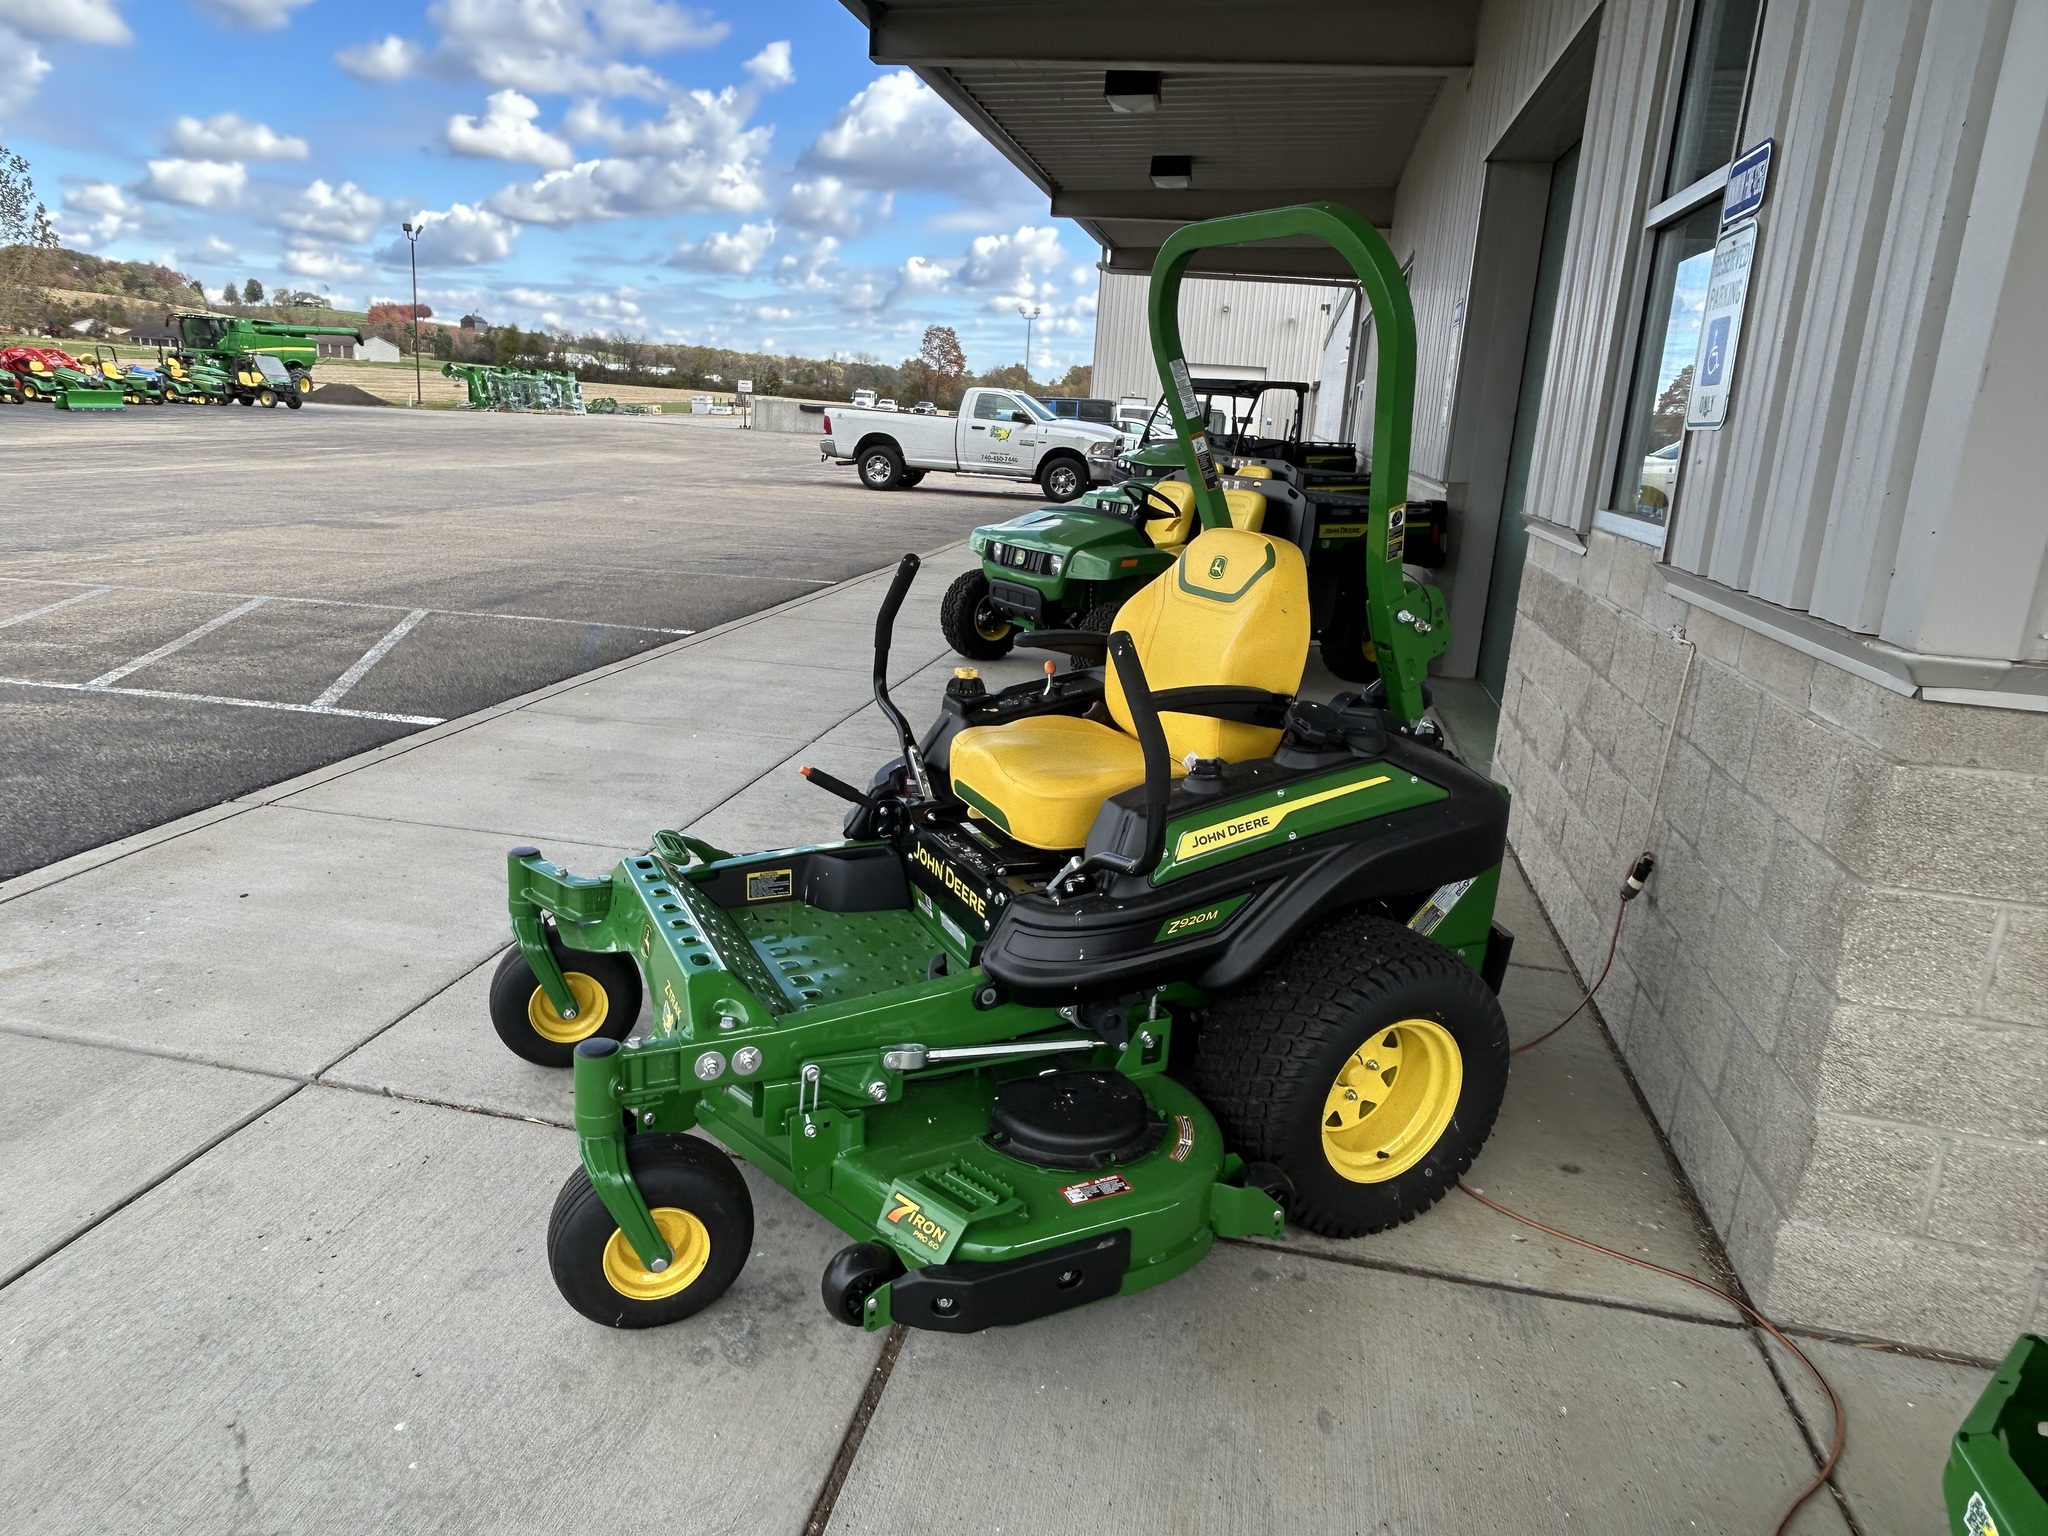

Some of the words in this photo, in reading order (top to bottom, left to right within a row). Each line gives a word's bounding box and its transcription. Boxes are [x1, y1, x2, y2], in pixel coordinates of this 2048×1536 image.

[1712, 242, 1750, 277] RESERVED
[1708, 279, 1743, 311] PARKING
[1699, 395, 1716, 413] ONLY
[1192, 830, 1226, 848] JOHN
[1227, 816, 1270, 836] DEERE
[914, 841, 944, 881] JOHN
[945, 866, 986, 919] DEERE
[1167, 910, 1219, 934] Z920M
[912, 1230, 928, 1243] PRO
[928, 1240, 939, 1250] 60
